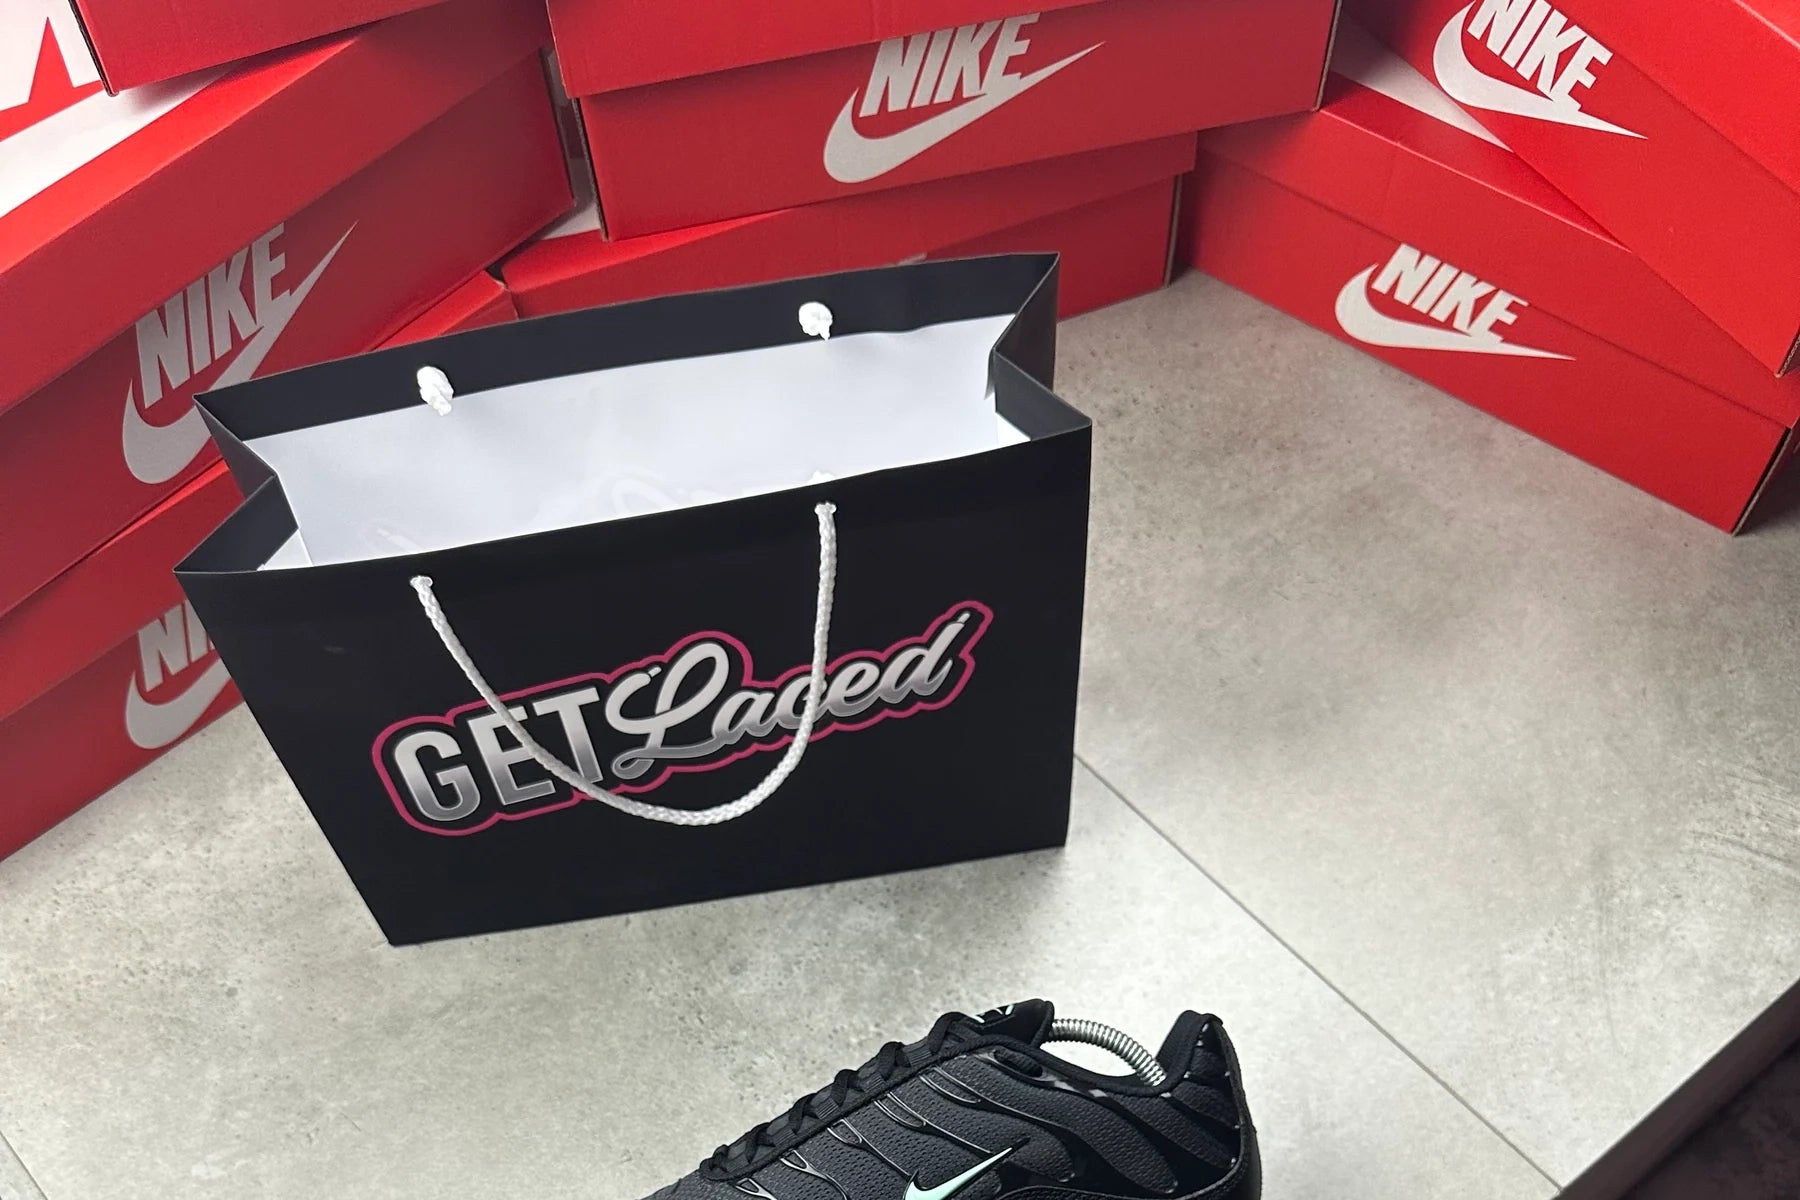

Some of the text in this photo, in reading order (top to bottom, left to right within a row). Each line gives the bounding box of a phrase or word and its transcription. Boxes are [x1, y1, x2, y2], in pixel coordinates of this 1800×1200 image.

[859, 12, 1041, 118] NIKE
[1467, 0, 1613, 113] NIKE
[136, 222, 292, 409] NIKE
[1371, 243, 1529, 343] NIKE
[138, 599, 216, 692] NI
[395, 611, 971, 822] GET Laced
